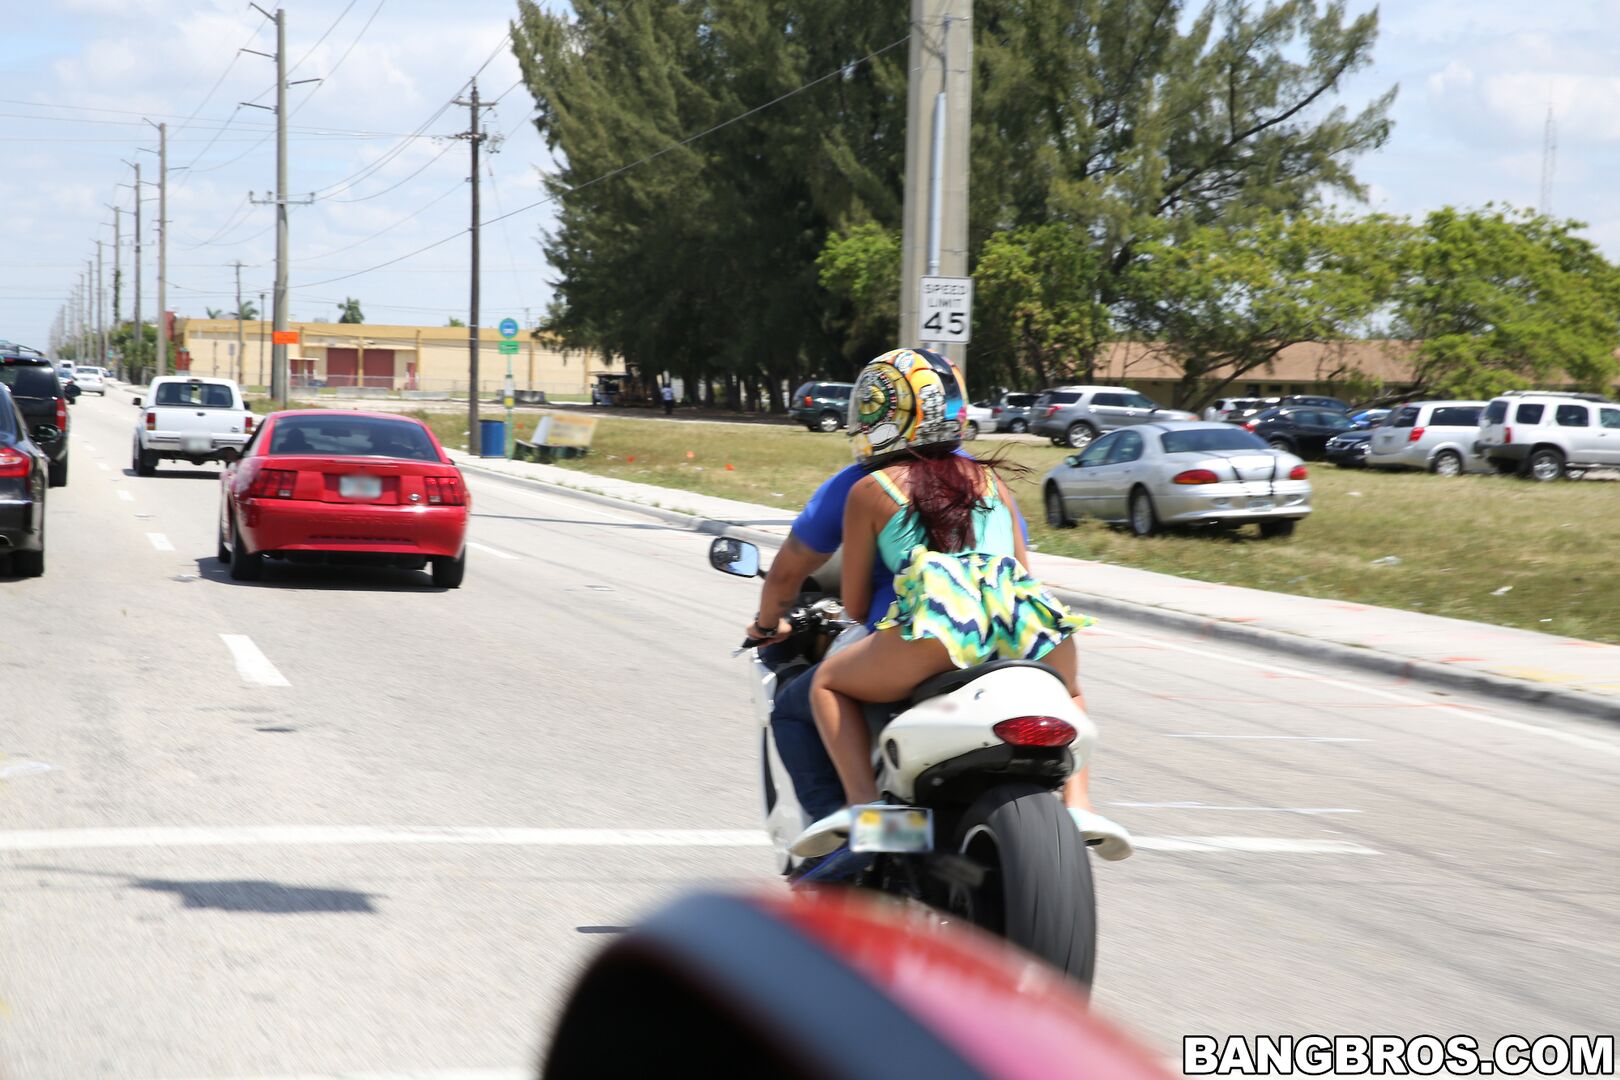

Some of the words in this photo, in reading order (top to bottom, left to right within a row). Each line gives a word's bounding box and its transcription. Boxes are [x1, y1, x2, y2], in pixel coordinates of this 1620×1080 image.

[924, 284, 966, 295] SPEED
[928, 298, 962, 308] LIMIT
[923, 311, 965, 335] 45
